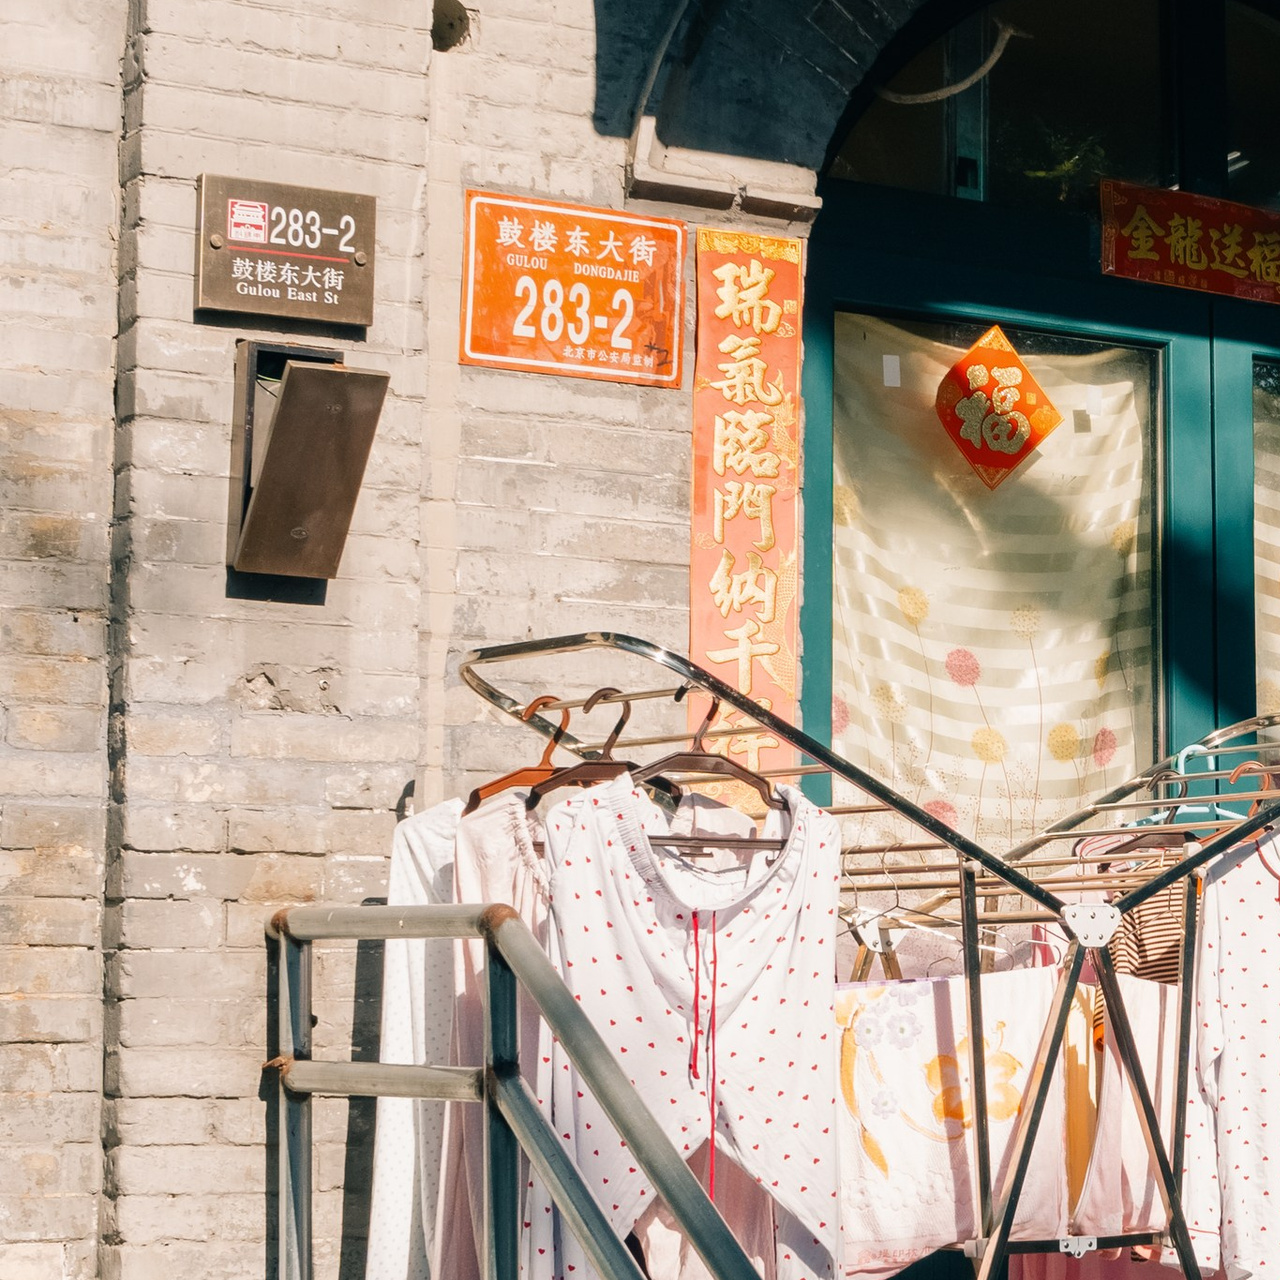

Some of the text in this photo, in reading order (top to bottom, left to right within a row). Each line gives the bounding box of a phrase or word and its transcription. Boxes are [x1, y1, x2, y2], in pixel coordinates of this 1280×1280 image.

[269, 206, 356, 253] 283-2
[496, 216, 657, 267] 鼓楼东大街
[231, 257, 345, 291] 鼓楼东大街
[506, 253, 640, 283] GULOU DONGDAJIE
[236, 282, 339, 305] Gulou East St
[512, 275, 634, 350] 283-2
[562, 345, 654, 369] 北京市公安局监制
[955, 364, 1031, 455] 福
